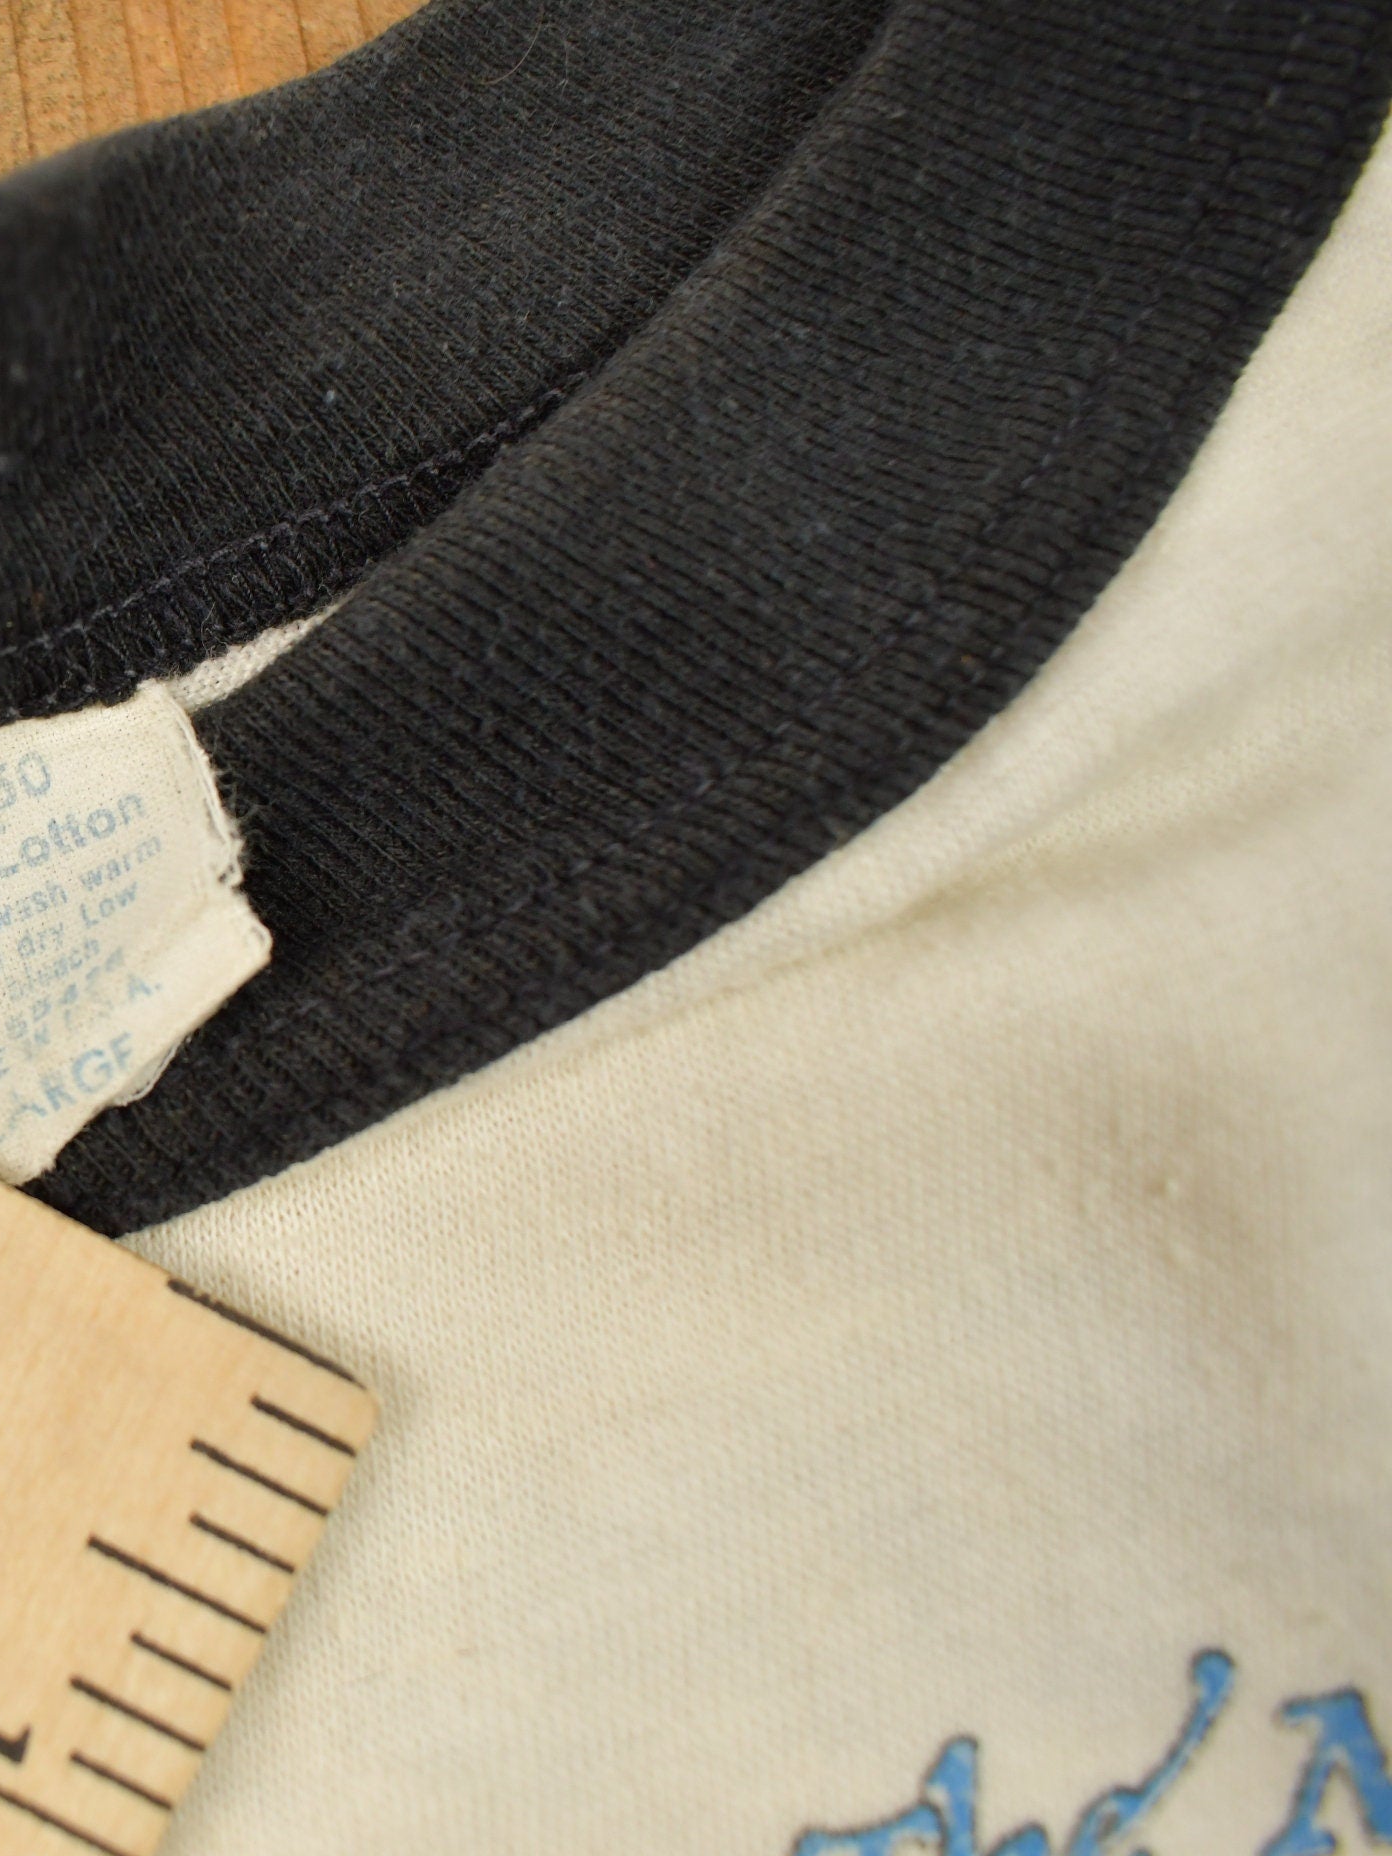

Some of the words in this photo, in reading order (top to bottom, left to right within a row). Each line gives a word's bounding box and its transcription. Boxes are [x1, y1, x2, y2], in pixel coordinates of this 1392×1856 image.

[80, 836, 161, 892] warm
[17, 921, 65, 959] dry
[80, 881, 138, 928] Low
